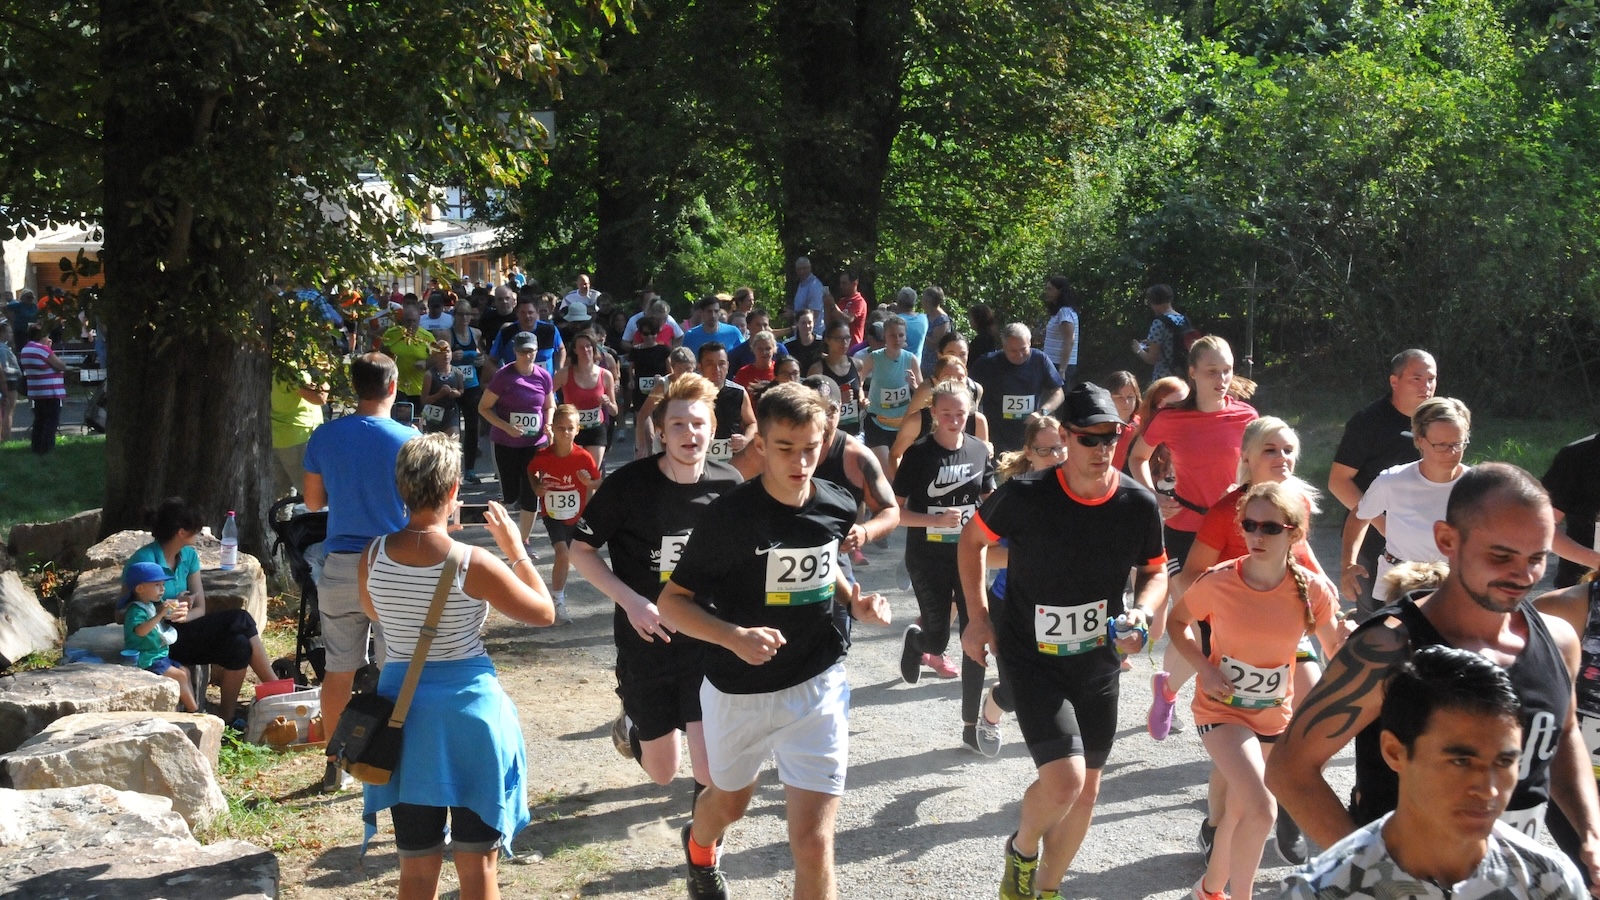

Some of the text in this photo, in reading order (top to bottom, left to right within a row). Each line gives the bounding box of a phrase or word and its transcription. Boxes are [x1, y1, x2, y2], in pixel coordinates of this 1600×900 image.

[643, 379, 655, 388] 29
[884, 388, 907, 401] 219
[840, 403, 854, 416] 95
[1007, 398, 1030, 410] 251
[514, 415, 537, 428] 200
[580, 410, 599, 422] 239
[708, 442, 729, 455] 61
[935, 463, 971, 485] NIKE
[549, 494, 576, 509] 138
[778, 551, 831, 583] 293
[1045, 609, 1099, 636] 218
[1230, 665, 1281, 694] 229
